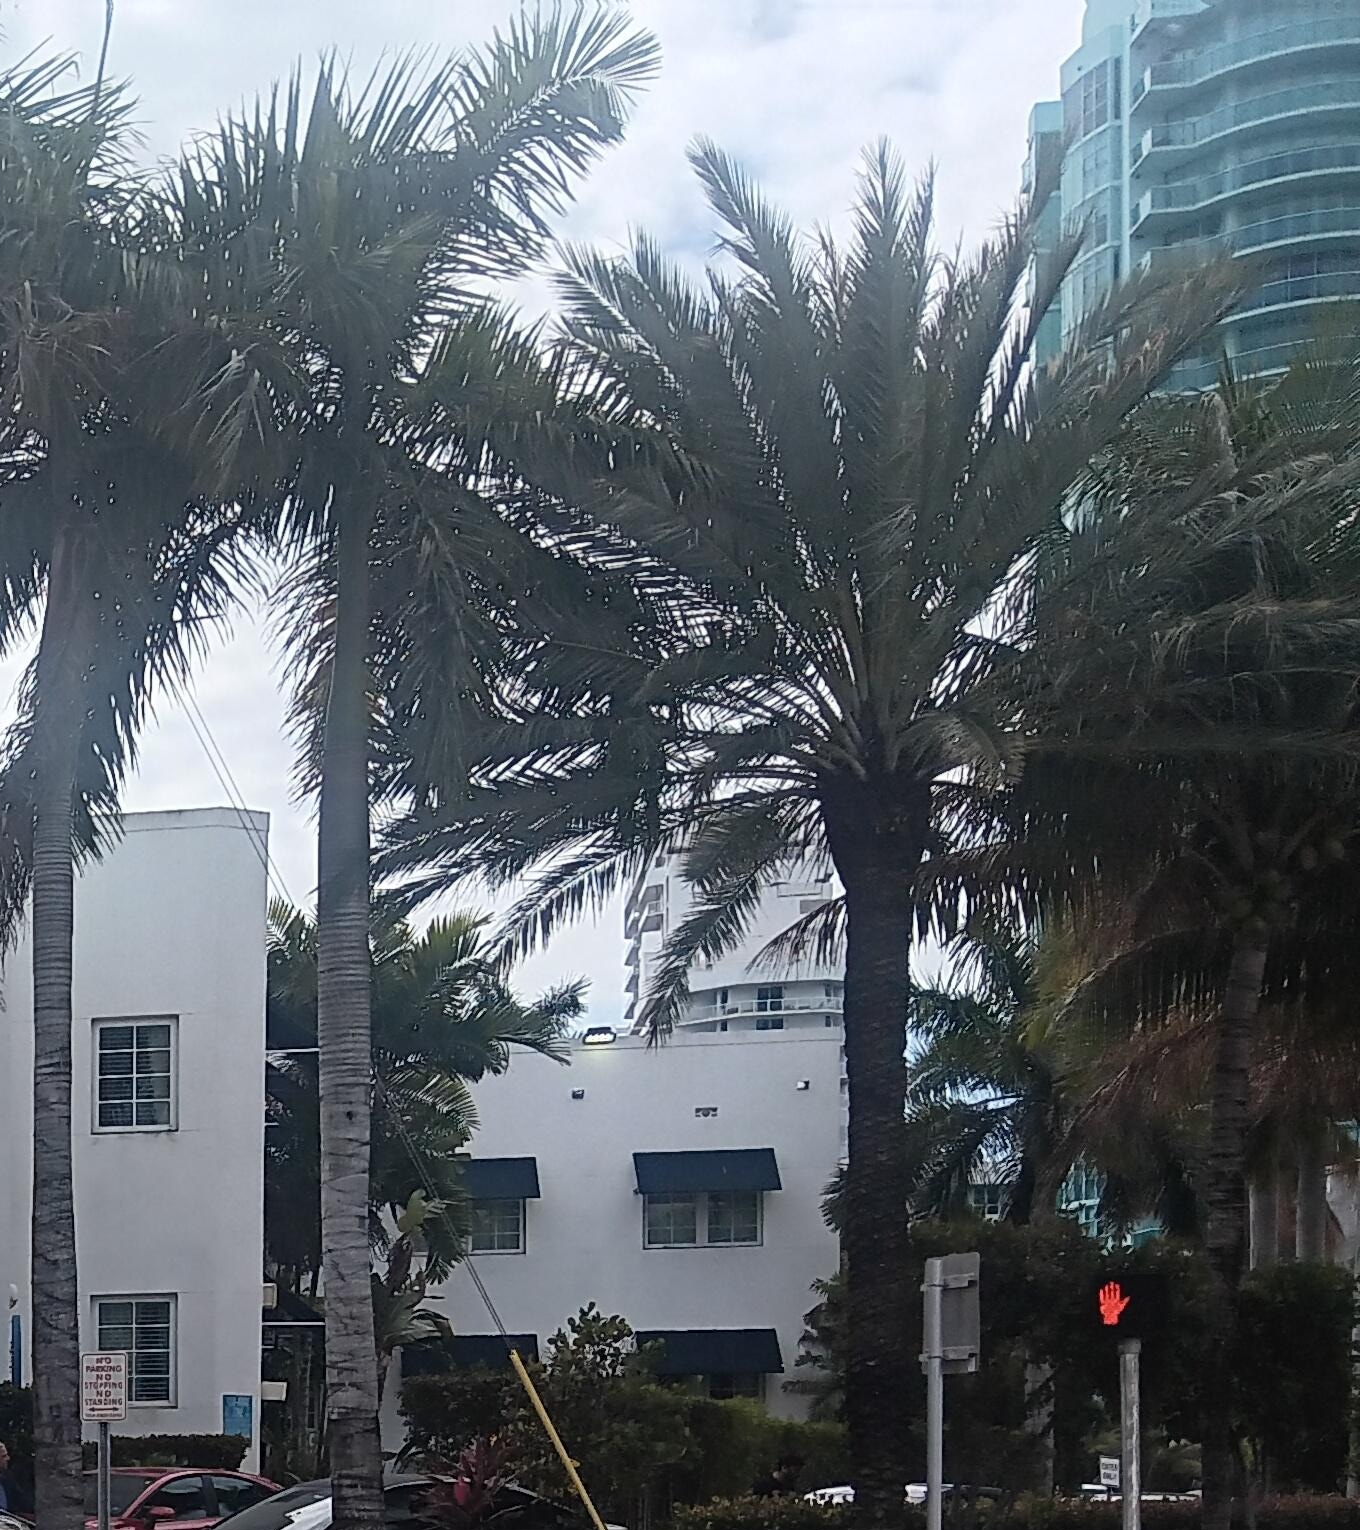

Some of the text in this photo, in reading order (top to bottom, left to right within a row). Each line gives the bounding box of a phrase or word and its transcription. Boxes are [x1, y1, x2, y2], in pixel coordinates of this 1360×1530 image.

[95, 1356, 112, 1364] NO
[85, 1365, 122, 1373] PARKING
[95, 1373, 112, 1381] NO
[84, 1381, 123, 1390] STOPPING
[95, 1390, 112, 1398] NO
[84, 1398, 123, 1406] STANDING
